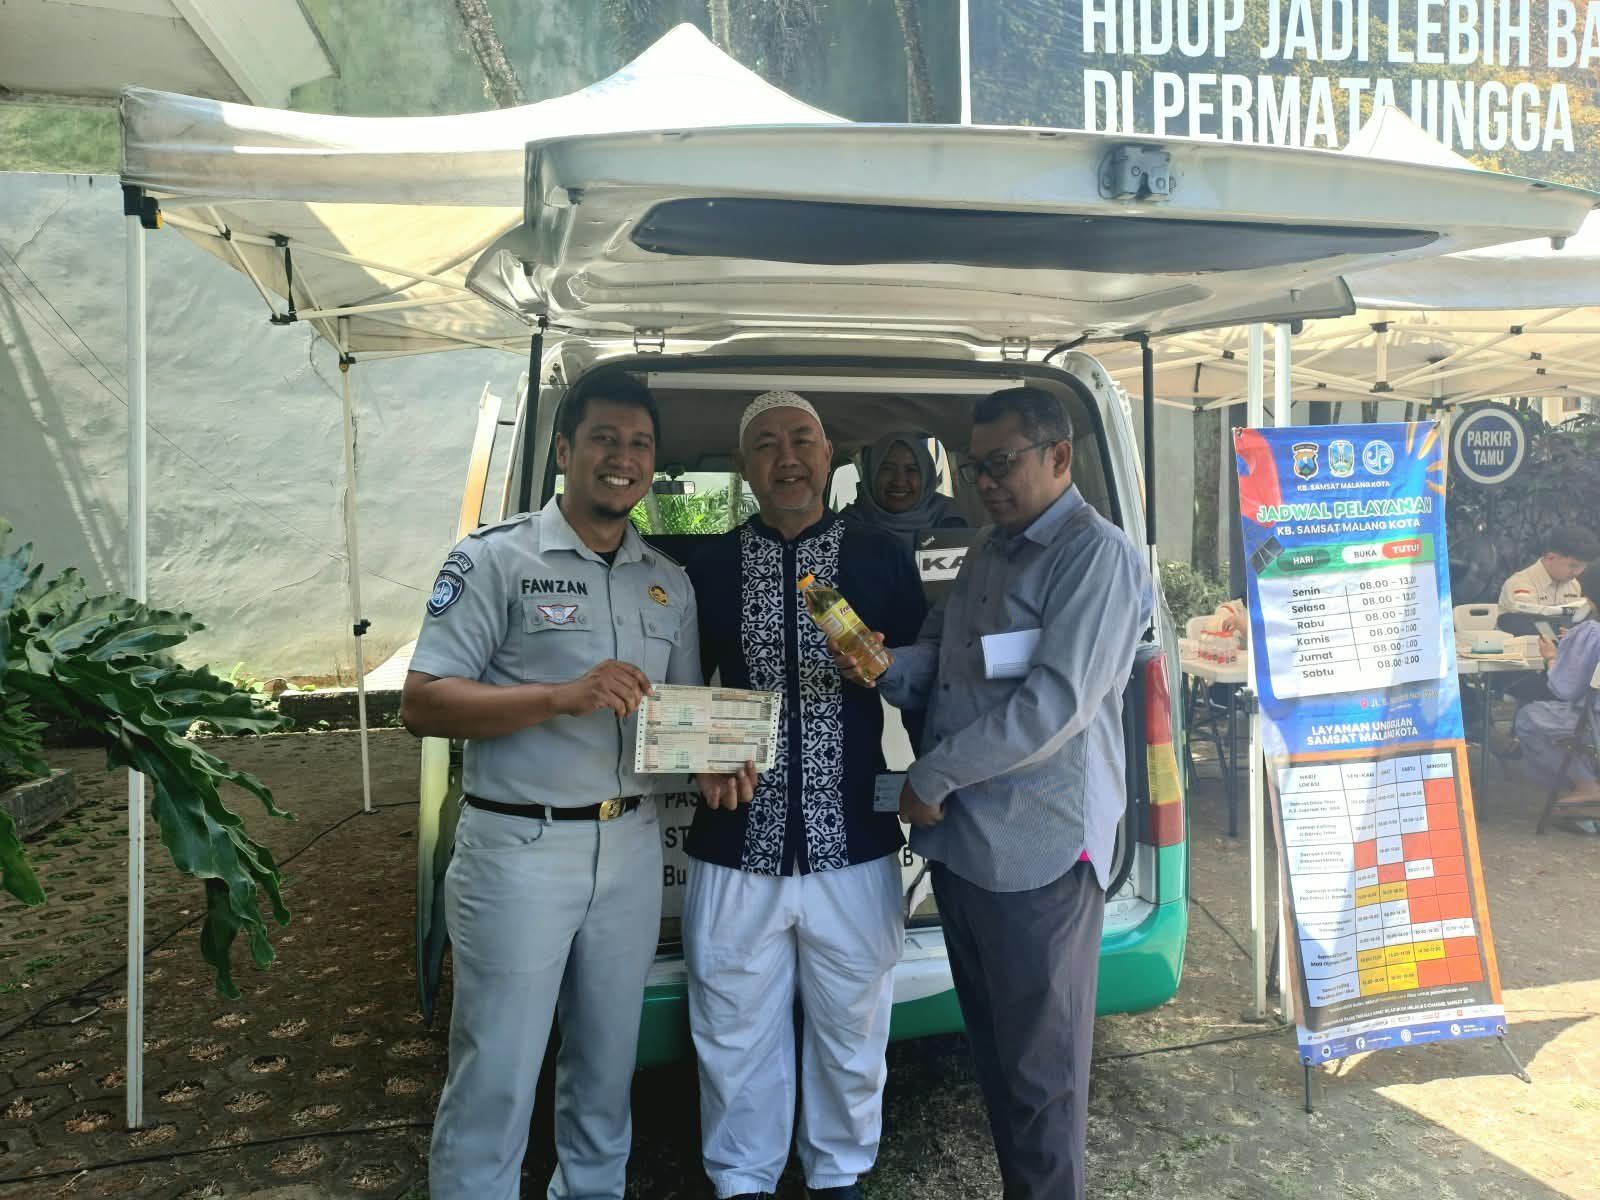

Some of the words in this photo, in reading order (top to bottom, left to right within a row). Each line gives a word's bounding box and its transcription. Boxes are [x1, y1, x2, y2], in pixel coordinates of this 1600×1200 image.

[1082, 0, 1245, 57] HIDUP
[1260, 0, 1369, 62] JADI
[1387, 0, 1529, 66] LEBIH
[1084, 69, 1134, 134] DI
[1467, 431, 1512, 447] PARKIR
[1473, 450, 1504, 466] TAMU
[1310, 483, 1340, 491] SAMSAT
[1257, 502, 1332, 523] JADWAL
[1277, 526, 1294, 536] KB.
[1297, 523, 1341, 535] SAMSAT
[1343, 520, 1387, 532] MALANG
[1389, 519, 1421, 530] KOTA
[1293, 555, 1314, 565] HARI
[1354, 549, 1378, 558] BUKA
[522, 578, 588, 596] FAWZAN
[1292, 587, 1320, 597] Senin
[1360, 580, 1389, 590] 08.00
[1291, 603, 1326, 614] Selasa
[1362, 595, 1392, 606] 08.00
[1297, 619, 1324, 630] Rabu
[1365, 611, 1396, 622] 08.00
[1297, 634, 1330, 646] Kamis
[1369, 626, 1400, 637] 08.00
[1299, 651, 1333, 662] Jumat
[1373, 642, 1401, 653] 08.00
[1303, 668, 1334, 679] Sabtu
[1377, 658, 1402, 669] 08.00
[1307, 734, 1357, 746] SAMSAT
[1395, 726, 1418, 737] KOTA
[1311, 722, 1369, 736] LAYANAN
[663, 865, 687, 887] Bu
